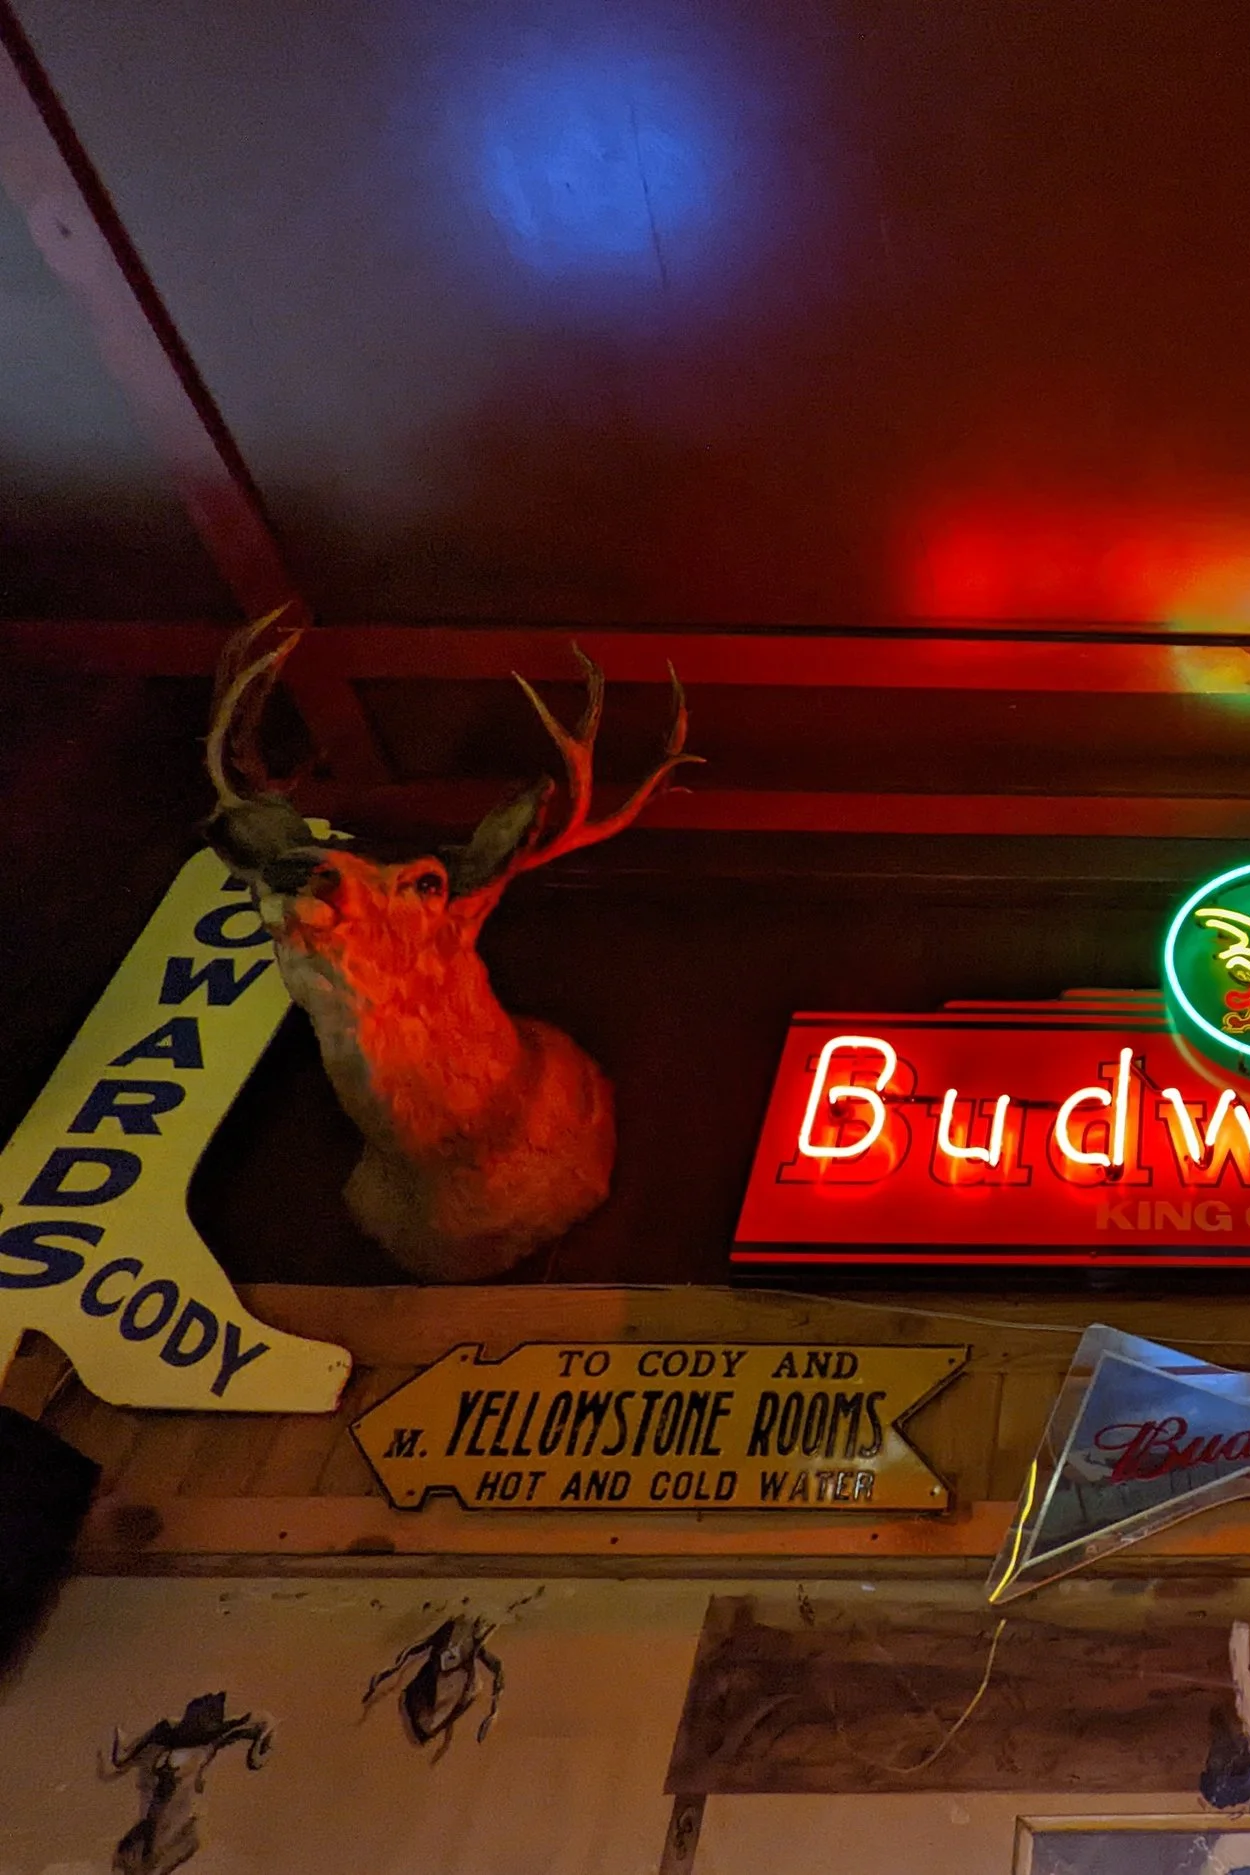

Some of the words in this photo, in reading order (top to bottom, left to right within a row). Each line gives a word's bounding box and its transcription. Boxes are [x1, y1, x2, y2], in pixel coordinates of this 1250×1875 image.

[0, 875, 274, 1289] OWARDS
[1096, 1199, 1233, 1232] KING
[80, 1258, 270, 1397] CODY
[559, 1351, 610, 1378] TO
[638, 1351, 743, 1379] CODY
[771, 1352, 859, 1380] AND
[445, 1390, 732, 1458] YELLOWSTONE
[746, 1390, 886, 1459] ROOMS
[475, 1470, 546, 1502] HOT
[560, 1471, 637, 1502] AND
[650, 1470, 735, 1502] COLD
[760, 1471, 875, 1502] WATER
